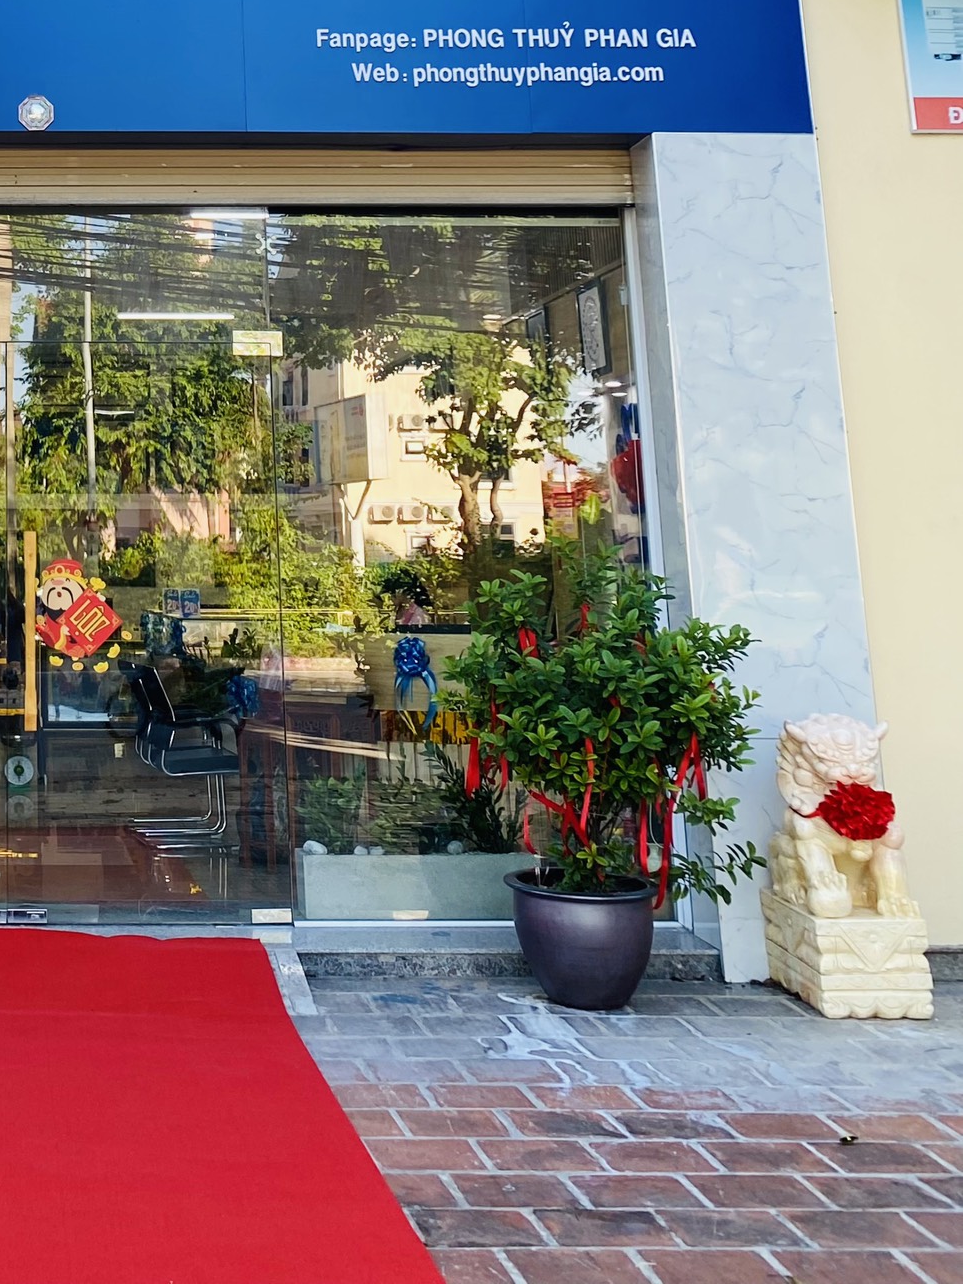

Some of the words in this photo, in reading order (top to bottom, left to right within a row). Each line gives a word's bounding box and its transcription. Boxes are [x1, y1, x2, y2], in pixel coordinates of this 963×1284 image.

[316, 28, 417, 53] Fanpage:
[423, 28, 505, 48] PHONG
[584, 28, 648, 48] PHAN
[655, 28, 697, 48] GIA
[413, 63, 665, 87] phongthuyphangia.com
[68, 599, 111, 643] LỘC
